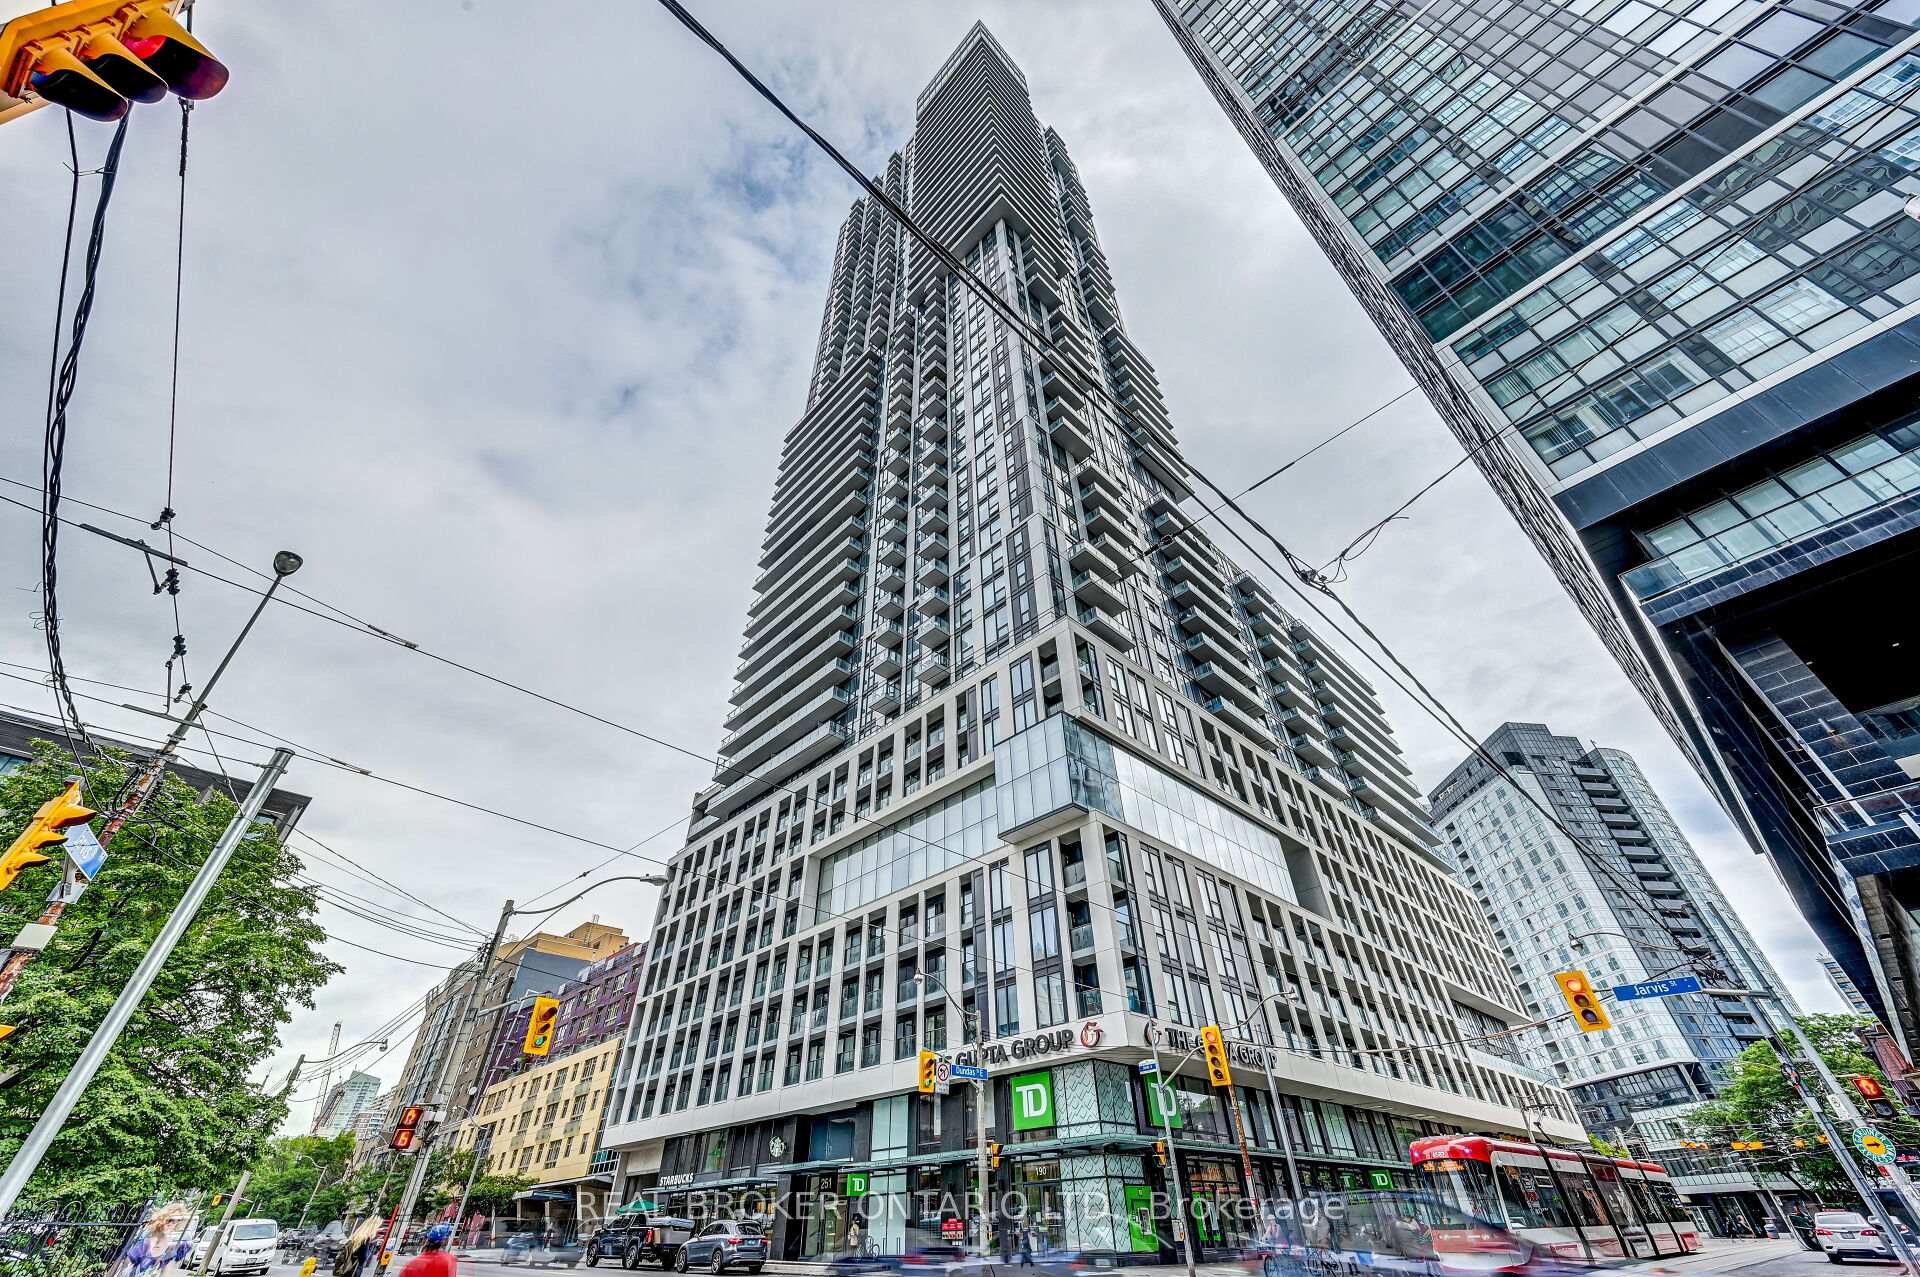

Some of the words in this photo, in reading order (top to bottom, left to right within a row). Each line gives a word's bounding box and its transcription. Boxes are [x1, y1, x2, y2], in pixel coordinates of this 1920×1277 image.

[1635, 983, 1669, 996] Jarvis
[1011, 1029, 1074, 1060] GROUP
[1165, 1028, 1193, 1051] THE
[956, 1067, 975, 1076] Dundas
[1016, 1083, 1047, 1118] TD
[1035, 1167, 1047, 1176] 190
[660, 1173, 694, 1186] STARBUCKS
[852, 1178, 865, 1191] TD
[1372, 1173, 1389, 1186] TD
